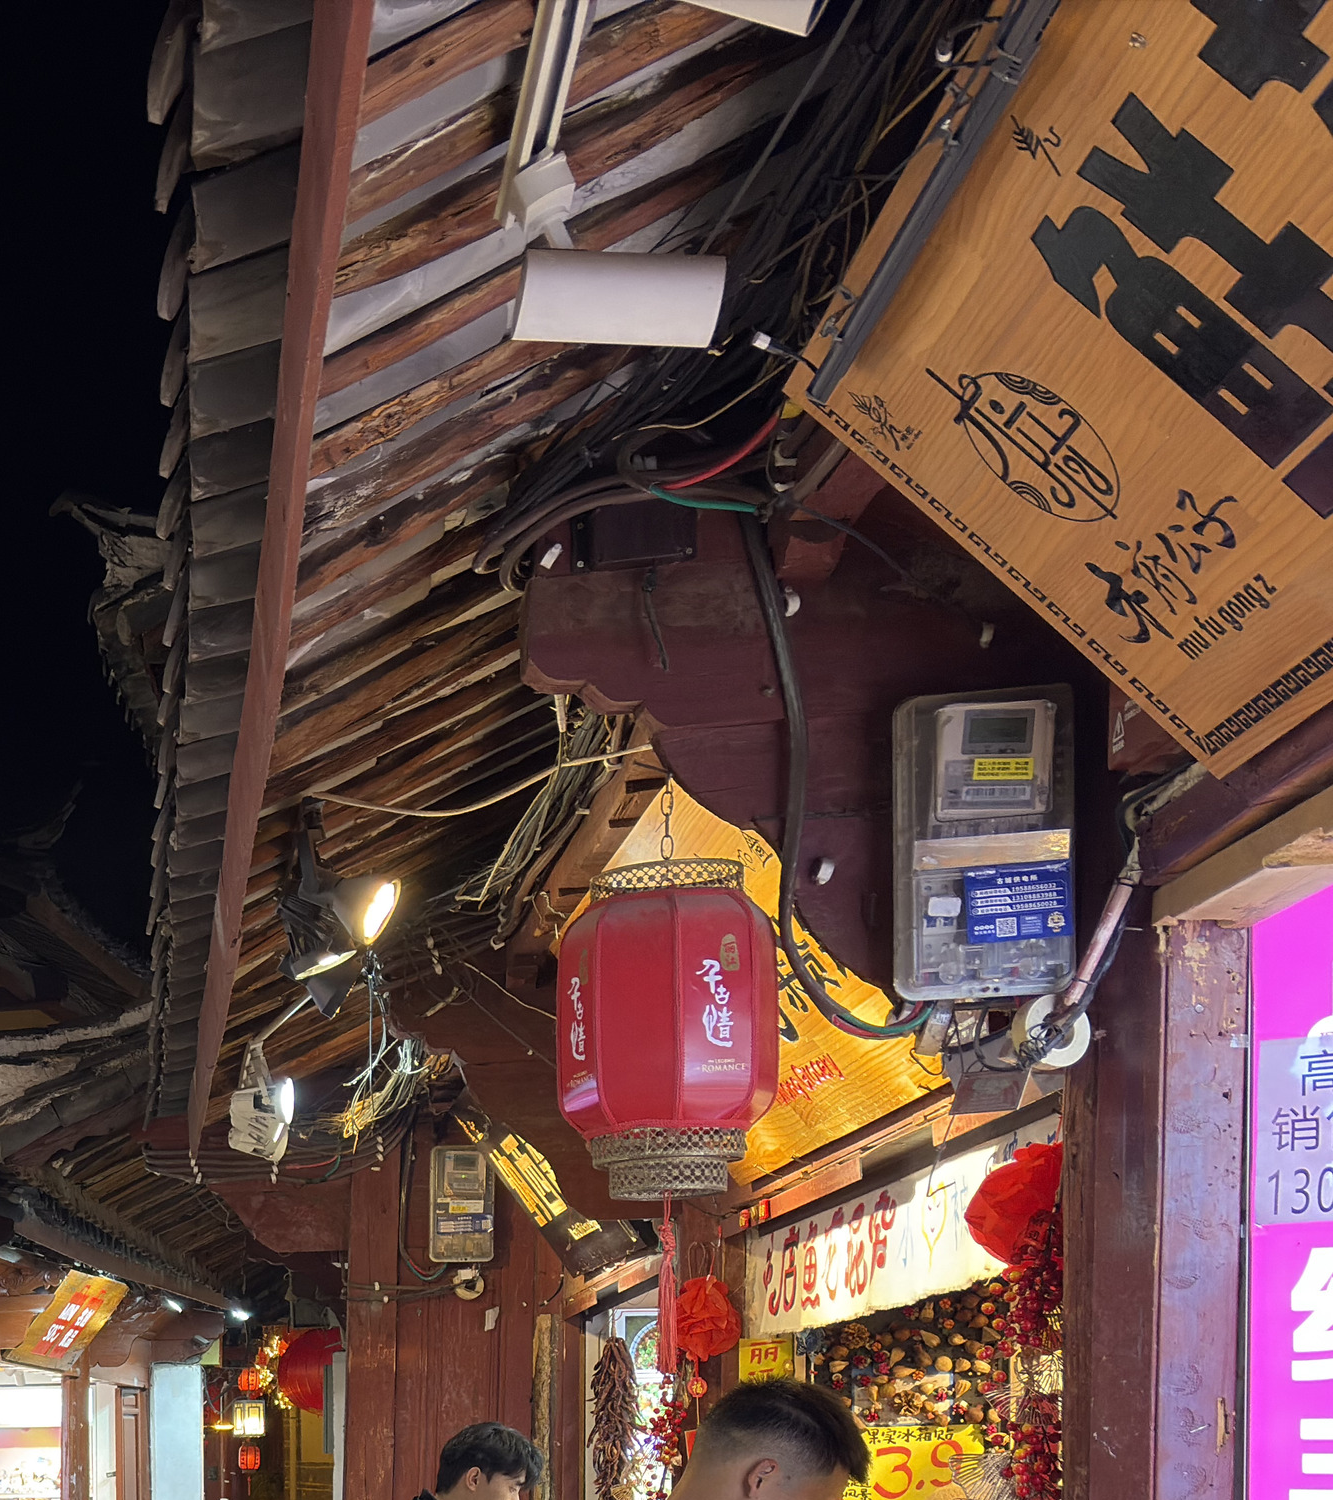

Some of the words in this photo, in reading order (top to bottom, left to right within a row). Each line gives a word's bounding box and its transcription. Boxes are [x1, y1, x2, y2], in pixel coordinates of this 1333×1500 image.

[702, 1062, 746, 1072] ROMANCE
[867, 1427, 955, 1444] 果实冰箱贴
